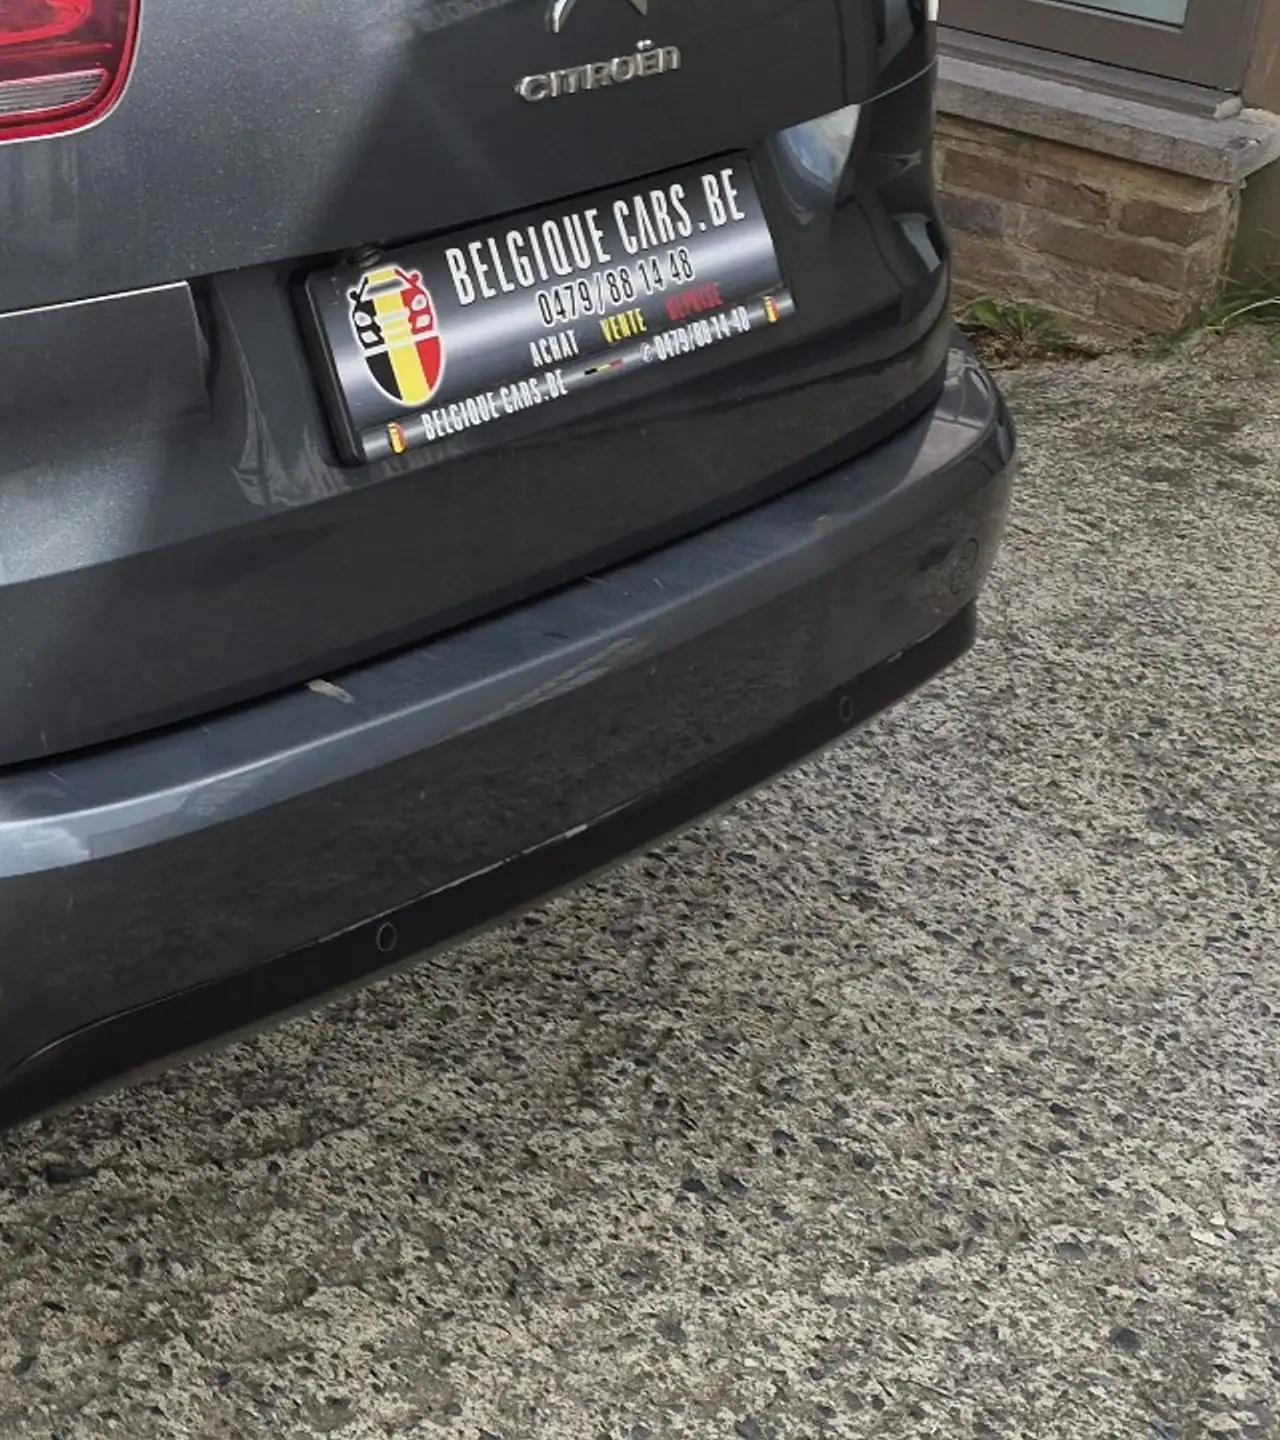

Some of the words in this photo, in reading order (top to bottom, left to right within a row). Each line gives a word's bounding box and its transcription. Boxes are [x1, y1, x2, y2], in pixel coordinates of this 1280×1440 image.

[445, 208, 611, 306] BELGIQUE
[637, 257, 667, 295] 14
[668, 246, 696, 284] 48
[529, 329, 581, 368] ACHAT
[598, 307, 648, 344] VENTE
[420, 391, 501, 441] BELGIQUE
